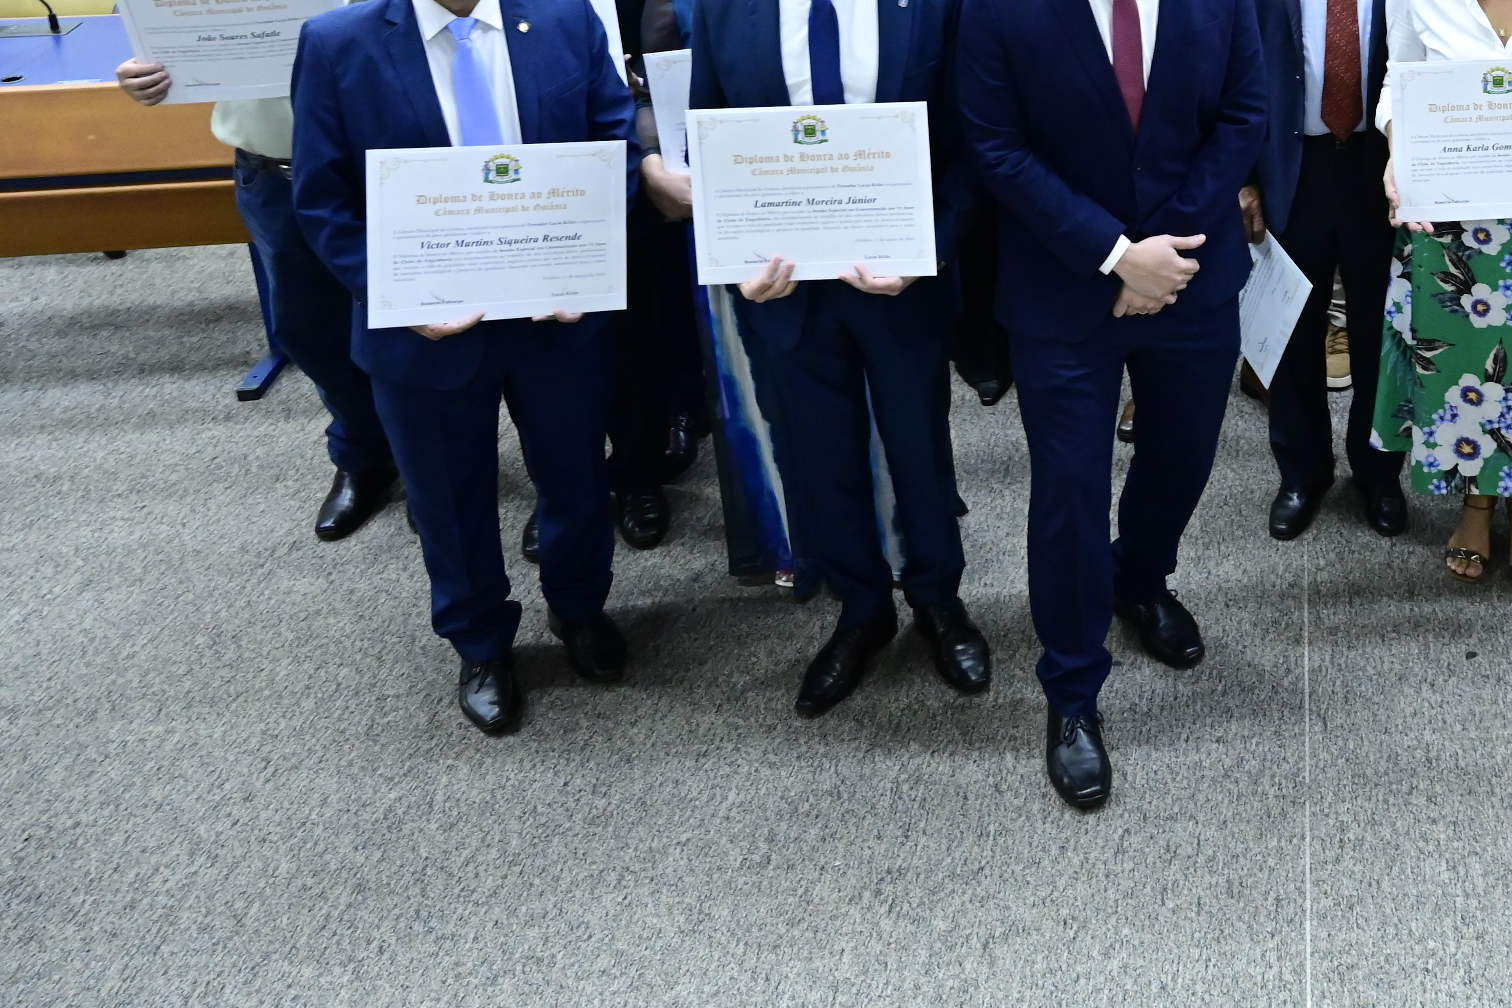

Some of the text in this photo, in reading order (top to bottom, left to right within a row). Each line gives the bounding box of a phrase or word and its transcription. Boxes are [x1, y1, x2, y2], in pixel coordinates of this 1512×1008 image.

[1428, 102, 1471, 114] Diploma
[1473, 101, 1483, 111] de
[1439, 143, 1463, 154] Anna
[1465, 143, 1490, 153] Karla
[733, 149, 891, 166] Diploma de Honra ao Mérito
[416, 187, 586, 205] Diploma de Honra ao Mérito
[753, 198, 803, 209] Lamartine
[806, 196, 843, 207] Moreira
[420, 232, 583, 250] Victor Martins Siqueira Resende
